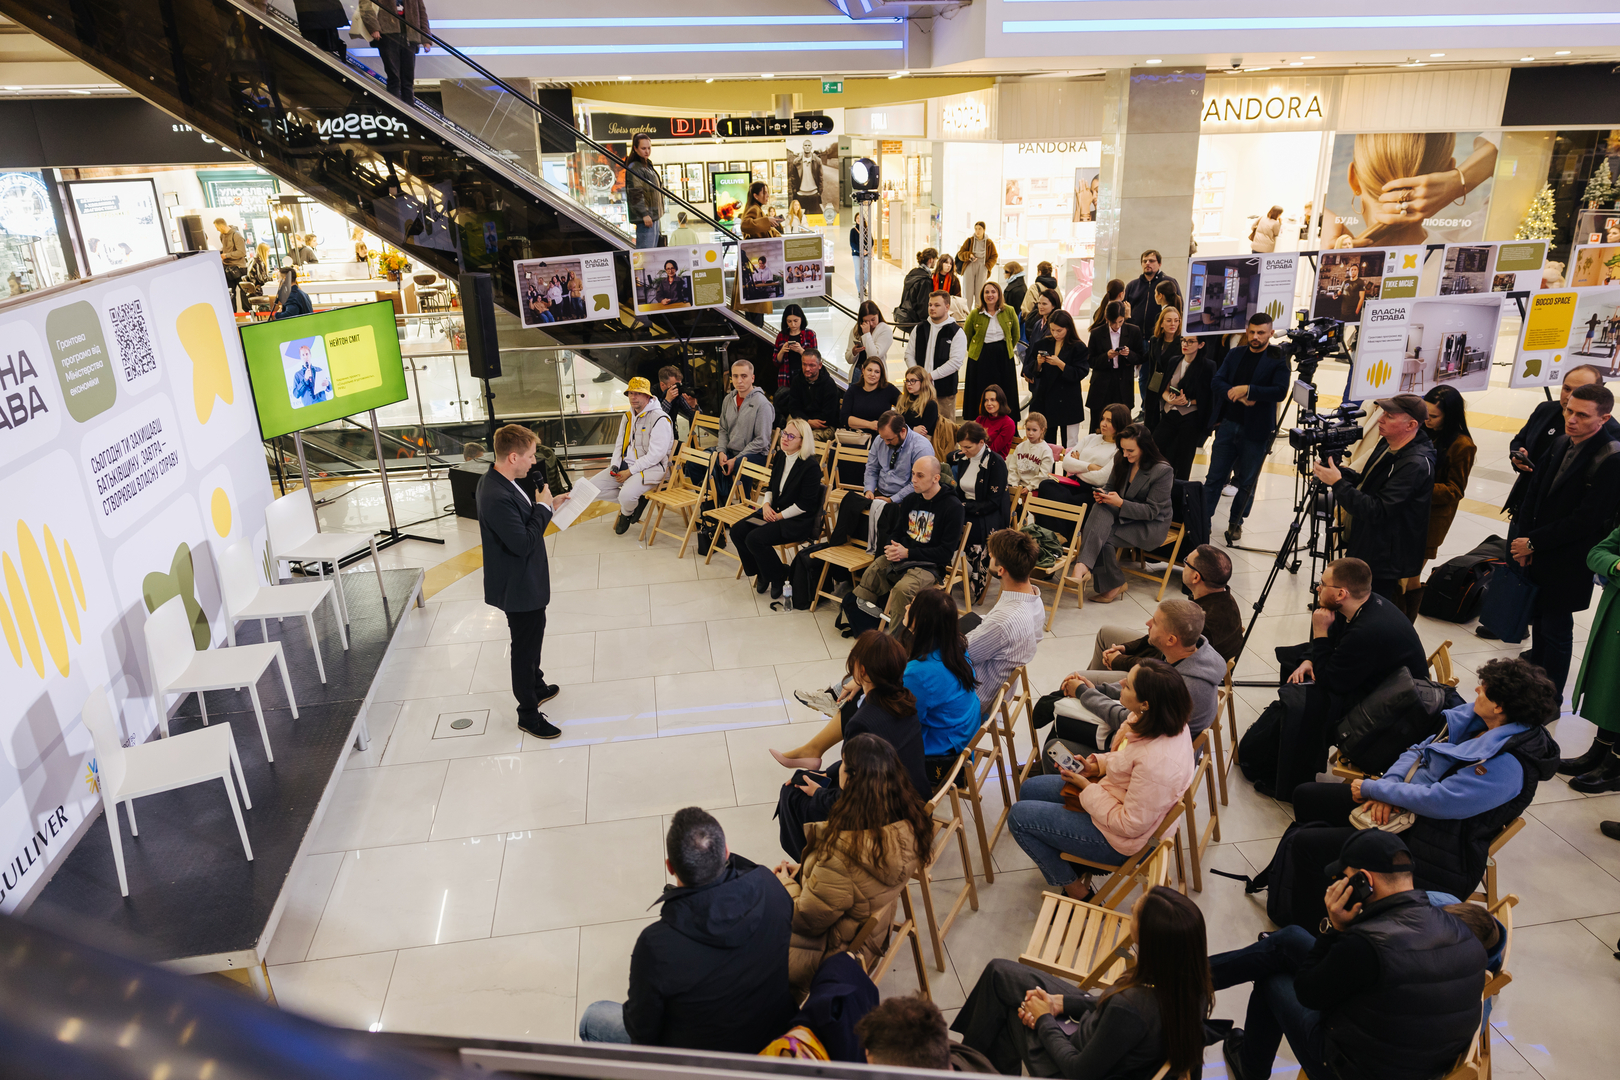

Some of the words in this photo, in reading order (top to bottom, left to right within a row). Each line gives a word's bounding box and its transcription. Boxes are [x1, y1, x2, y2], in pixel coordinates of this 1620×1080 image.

[726, 121, 733, 135] 1
[1018, 141, 1088, 154] PANDORA
[1334, 216, 1359, 225] БУДЬ
[1370, 314, 1405, 322] СПРАВА
[1371, 307, 1406, 316] ВЛАСНА
[56, 333, 86, 351] Грантова
[348, 334, 360, 344] СМІТ
[61, 349, 92, 368] програма
[91, 344, 101, 355] від
[70, 377, 100, 396] економіки
[90, 442, 123, 474] СЬОГОДНІ
[121, 436, 132, 454] ТИ
[129, 417, 162, 449] ЗАХИЩАЄШ
[140, 440, 163, 465] ЗАВТРА
[102, 480, 138, 516] СТВОРЮЄШ
[135, 463, 159, 492] ВЛАСНУ
[158, 449, 179, 475] СПРАВУ
[0, 805, 69, 904] ULLIVER
